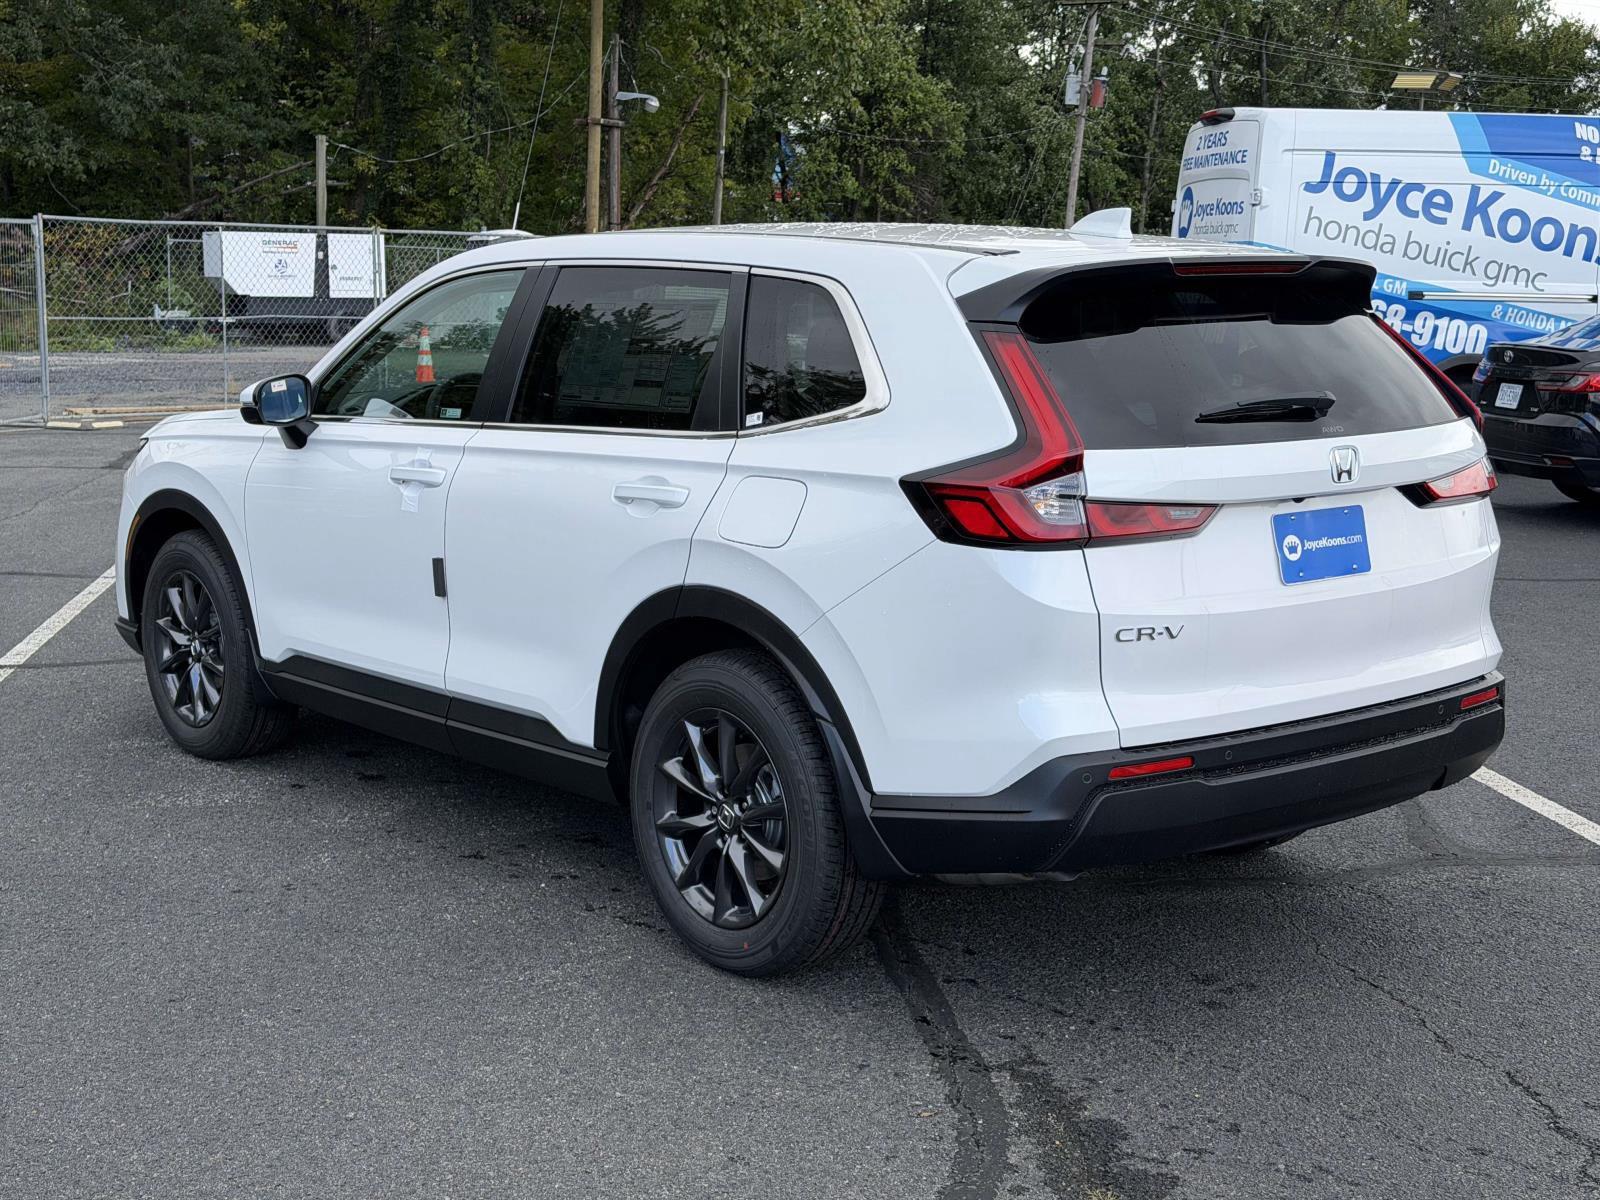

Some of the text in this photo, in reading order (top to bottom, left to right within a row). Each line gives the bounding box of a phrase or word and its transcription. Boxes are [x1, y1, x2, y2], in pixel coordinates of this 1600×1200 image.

[1196, 130, 1229, 151] 2 YEARS
[1194, 150, 1248, 168] MAINTENANCE
[1580, 145, 1593, 162] &
[1488, 159, 1537, 186] Driven
[1539, 174, 1558, 196] by
[1193, 198, 1244, 221] Joyce Koons
[1302, 151, 1600, 266] Joyce Koon
[1303, 206, 1547, 292] honda buick gmc
[1383, 279, 1408, 297] GM
[1491, 304, 1503, 320] &
[1505, 307, 1555, 332] HONDA
[1303, 534, 1362, 552] JoyceKoons.com
[1115, 624, 1185, 643] CR-V
